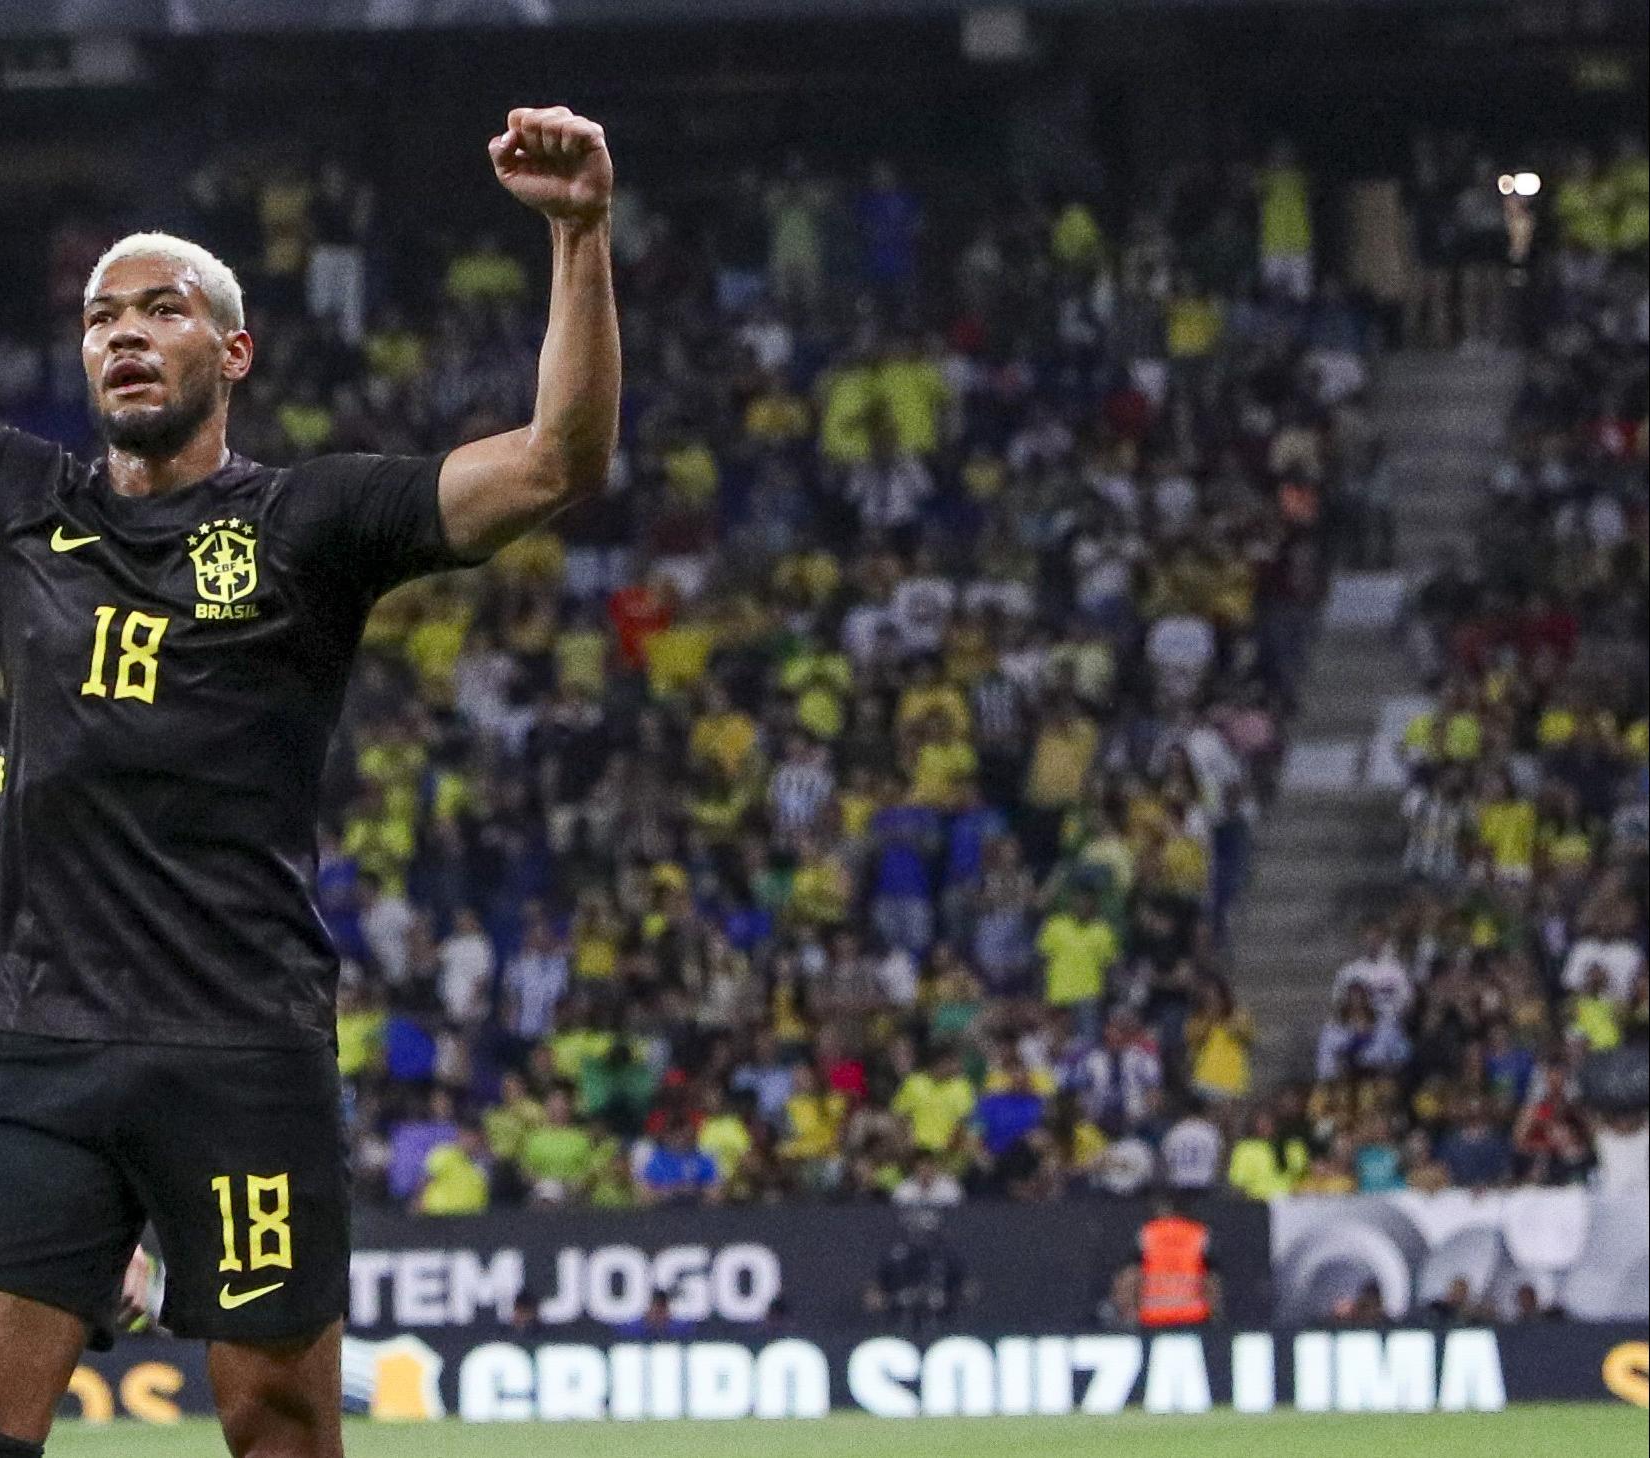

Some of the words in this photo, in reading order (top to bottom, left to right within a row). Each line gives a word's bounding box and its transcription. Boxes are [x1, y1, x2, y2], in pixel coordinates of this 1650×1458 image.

[214, 562, 237, 573] CBF
[194, 602, 261, 620] BRASIL
[80, 605, 170, 704] 18
[211, 1172, 293, 1273] 18
[350, 1250, 524, 1325] TEM
[538, 1243, 781, 1324] JOGO
[458, 1340, 831, 1422] GRUPO
[849, 1332, 1213, 1418] SOUZA
